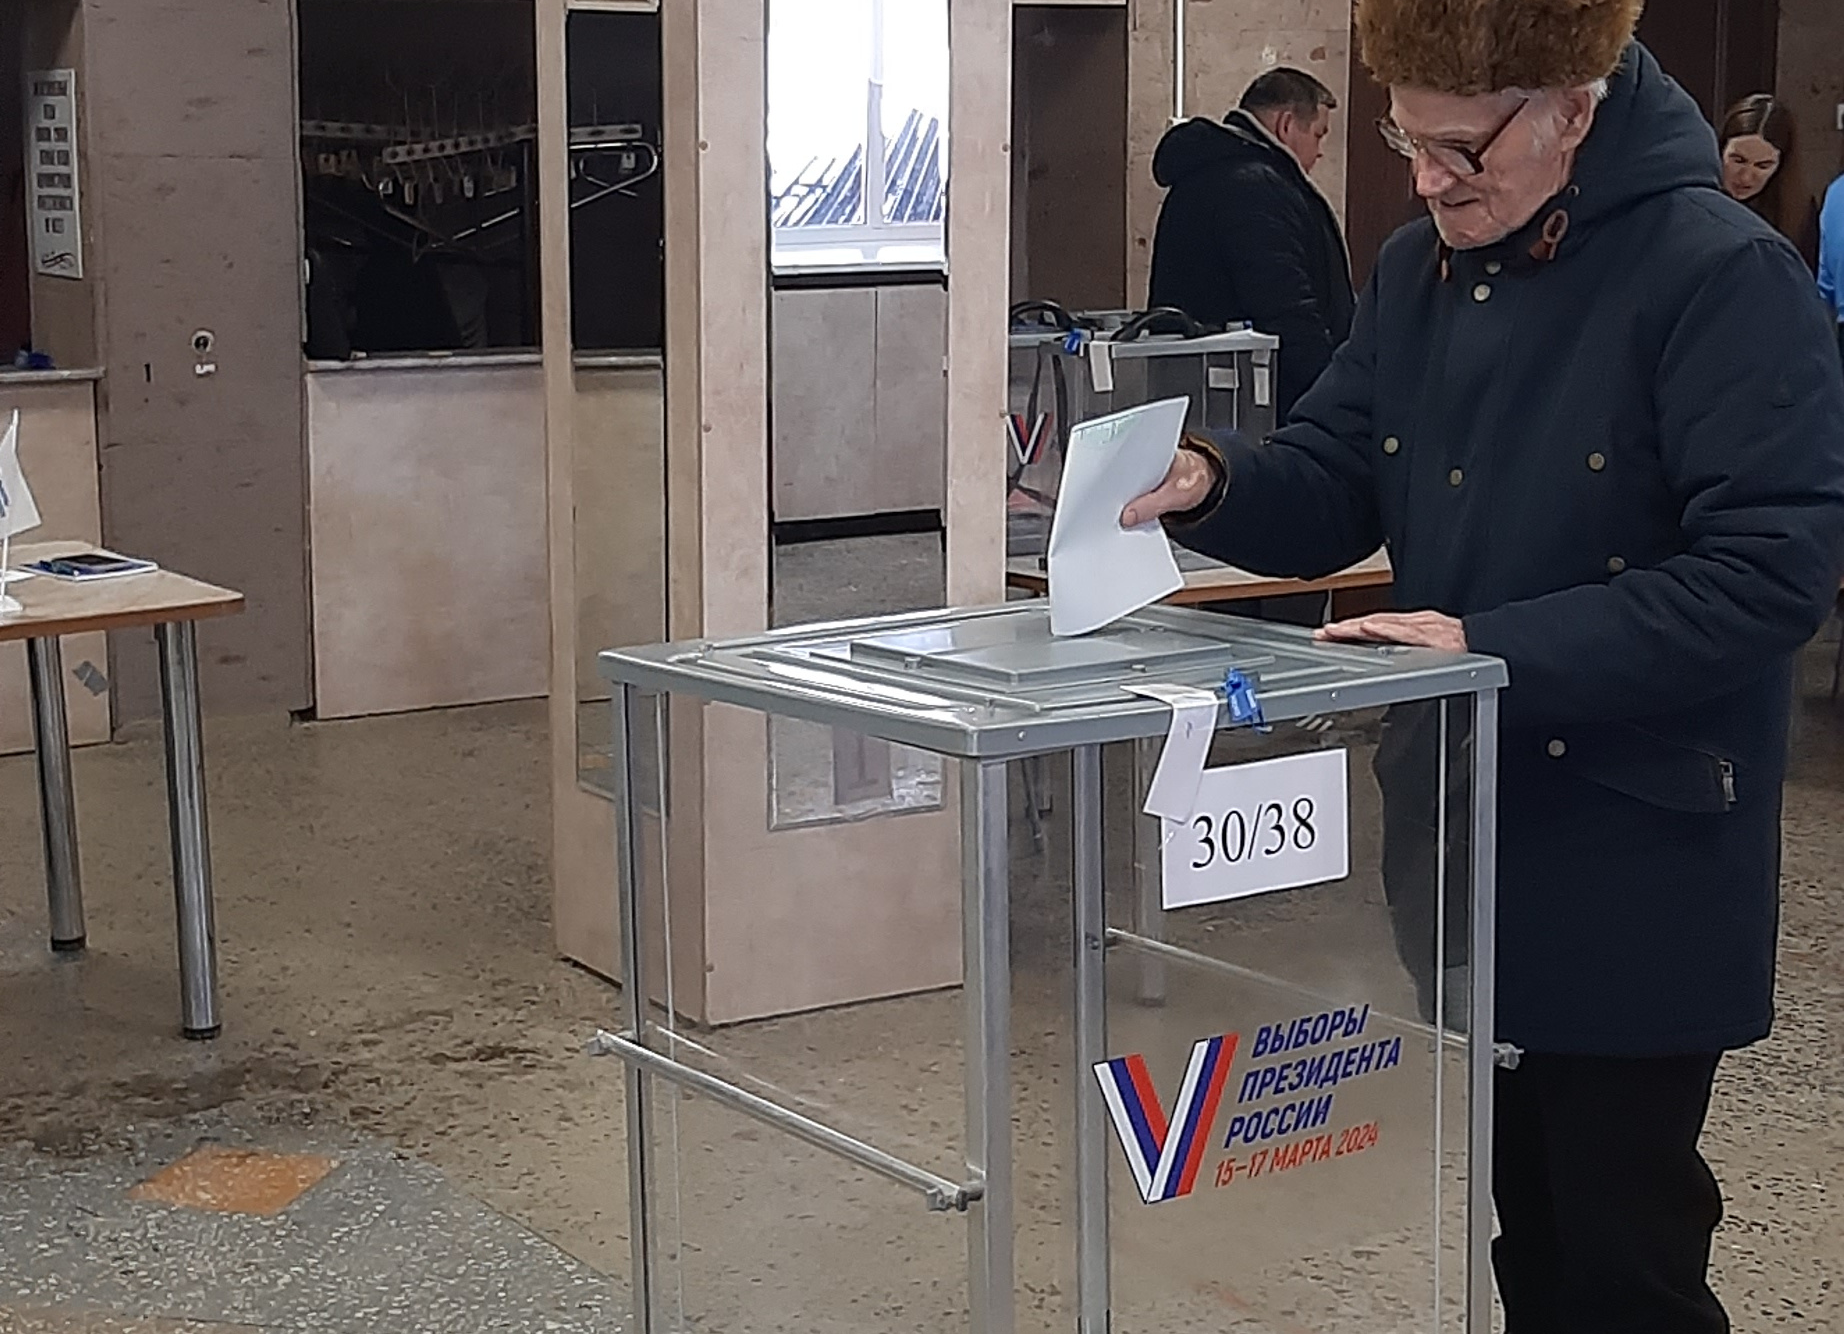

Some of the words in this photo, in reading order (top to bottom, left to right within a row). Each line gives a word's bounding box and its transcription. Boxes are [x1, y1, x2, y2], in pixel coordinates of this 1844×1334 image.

[1192, 798, 1316, 869] 30/38
[1252, 1004, 1369, 1058] ВЫБОРЫ
[1237, 1037, 1402, 1103] ПРЕЗИДЕНТА
[1224, 1094, 1333, 1148] РОССИИ
[1269, 1140, 1333, 1175] МАРТА
[1334, 1122, 1379, 1157] 2024
